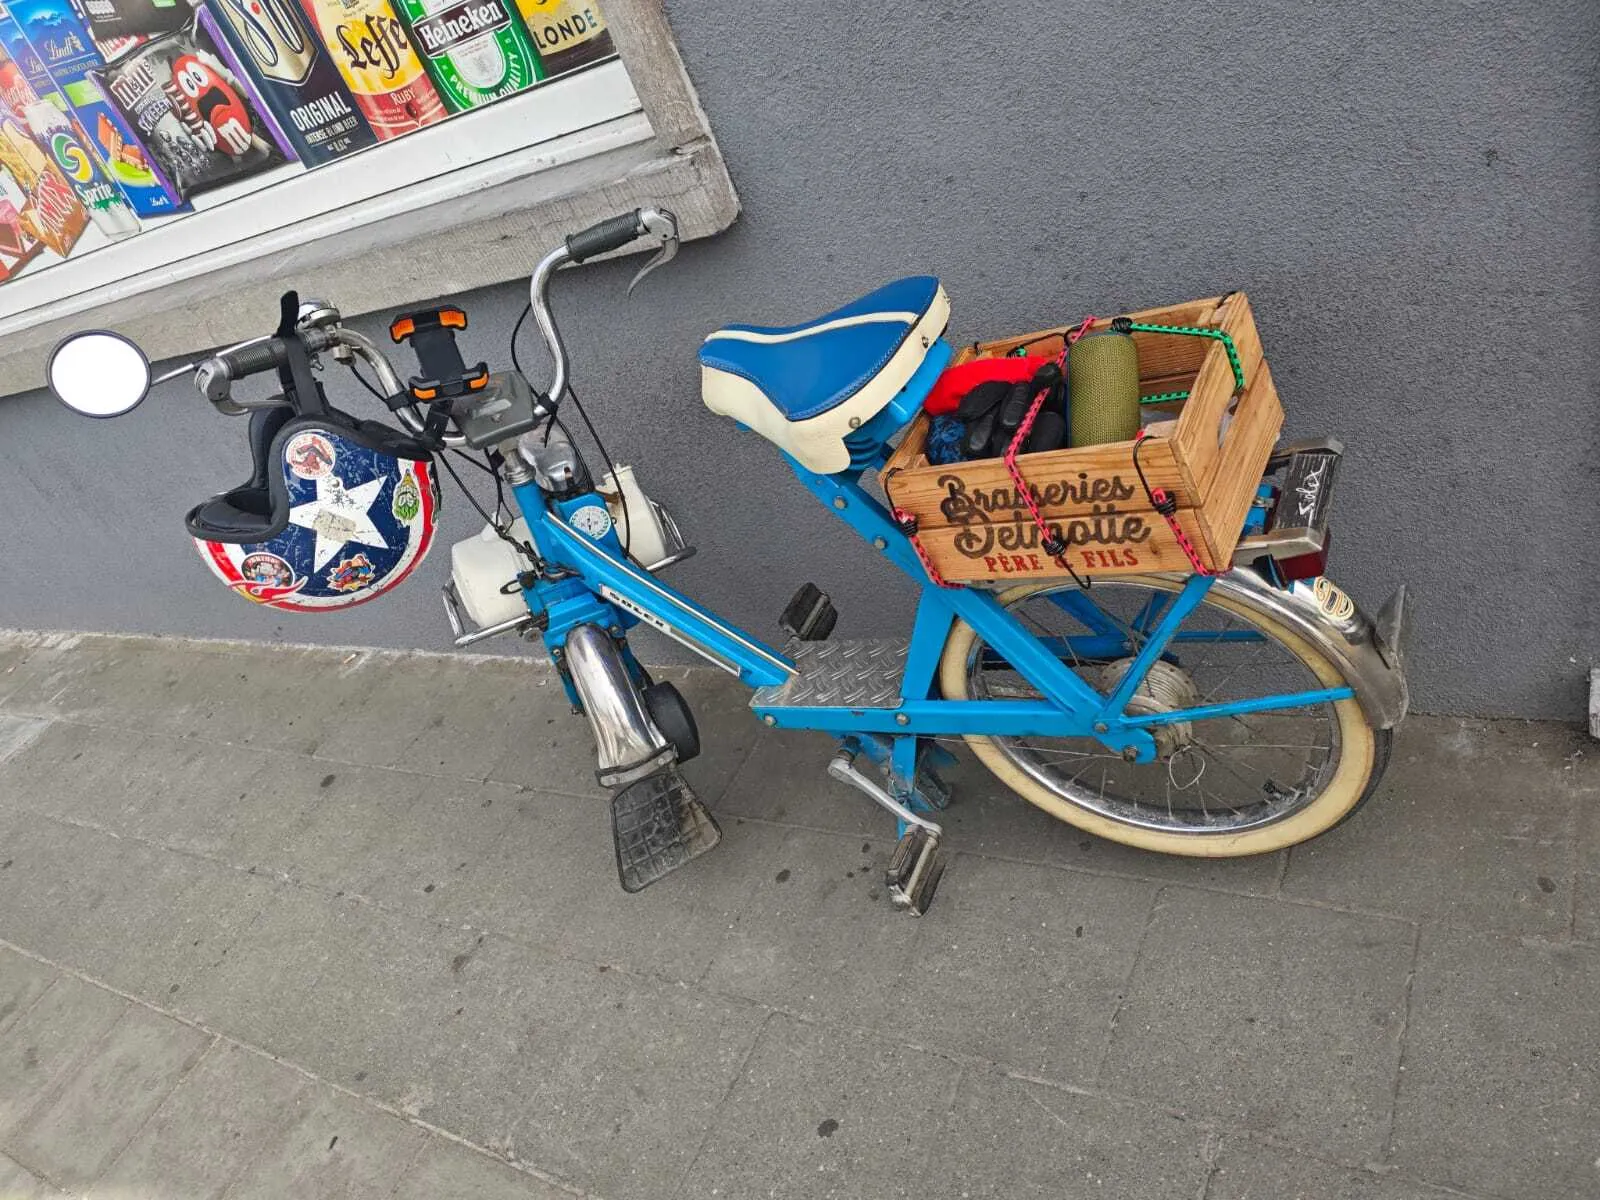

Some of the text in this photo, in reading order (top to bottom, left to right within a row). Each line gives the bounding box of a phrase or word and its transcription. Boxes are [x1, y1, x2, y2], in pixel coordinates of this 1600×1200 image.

[45, 33, 74, 61] Lindt
[336, 14, 408, 80] Leffe
[419, 2, 503, 50] Heineken
[533, 8, 598, 49] LONDE
[499, 52, 521, 97] QUALITY
[289, 90, 352, 132] ORIGINAL
[74, 182, 114, 209] Sprite
[937, 473, 1135, 524] Brasseries
[953, 502, 1152, 560] Delmotte
[983, 553, 1044, 573] PÈRE
[1081, 548, 1138, 569] FILS
